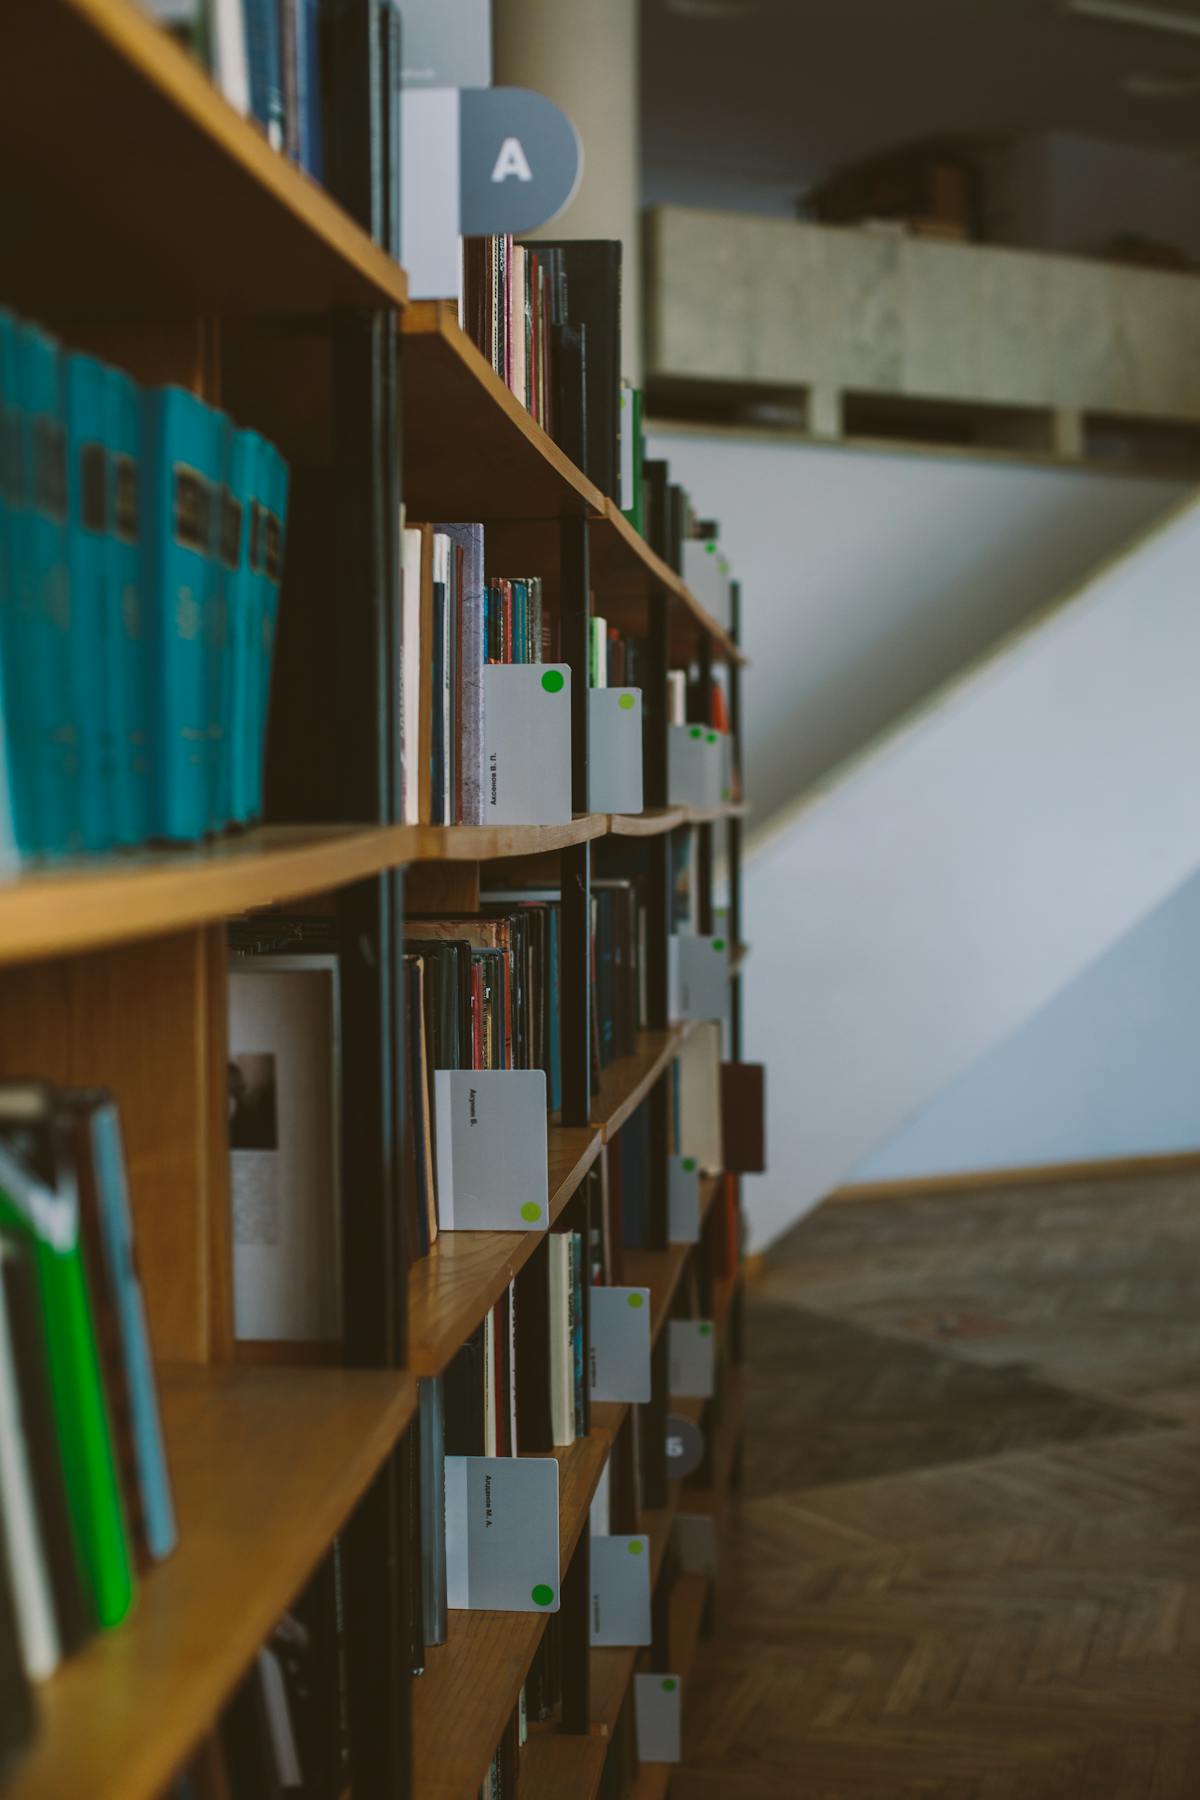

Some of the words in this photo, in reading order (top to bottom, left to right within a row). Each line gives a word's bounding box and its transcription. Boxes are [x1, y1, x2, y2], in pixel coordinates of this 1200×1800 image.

[490, 137, 533, 182] А
[490, 753, 497, 761] П.
[490, 763, 497, 771] В.
